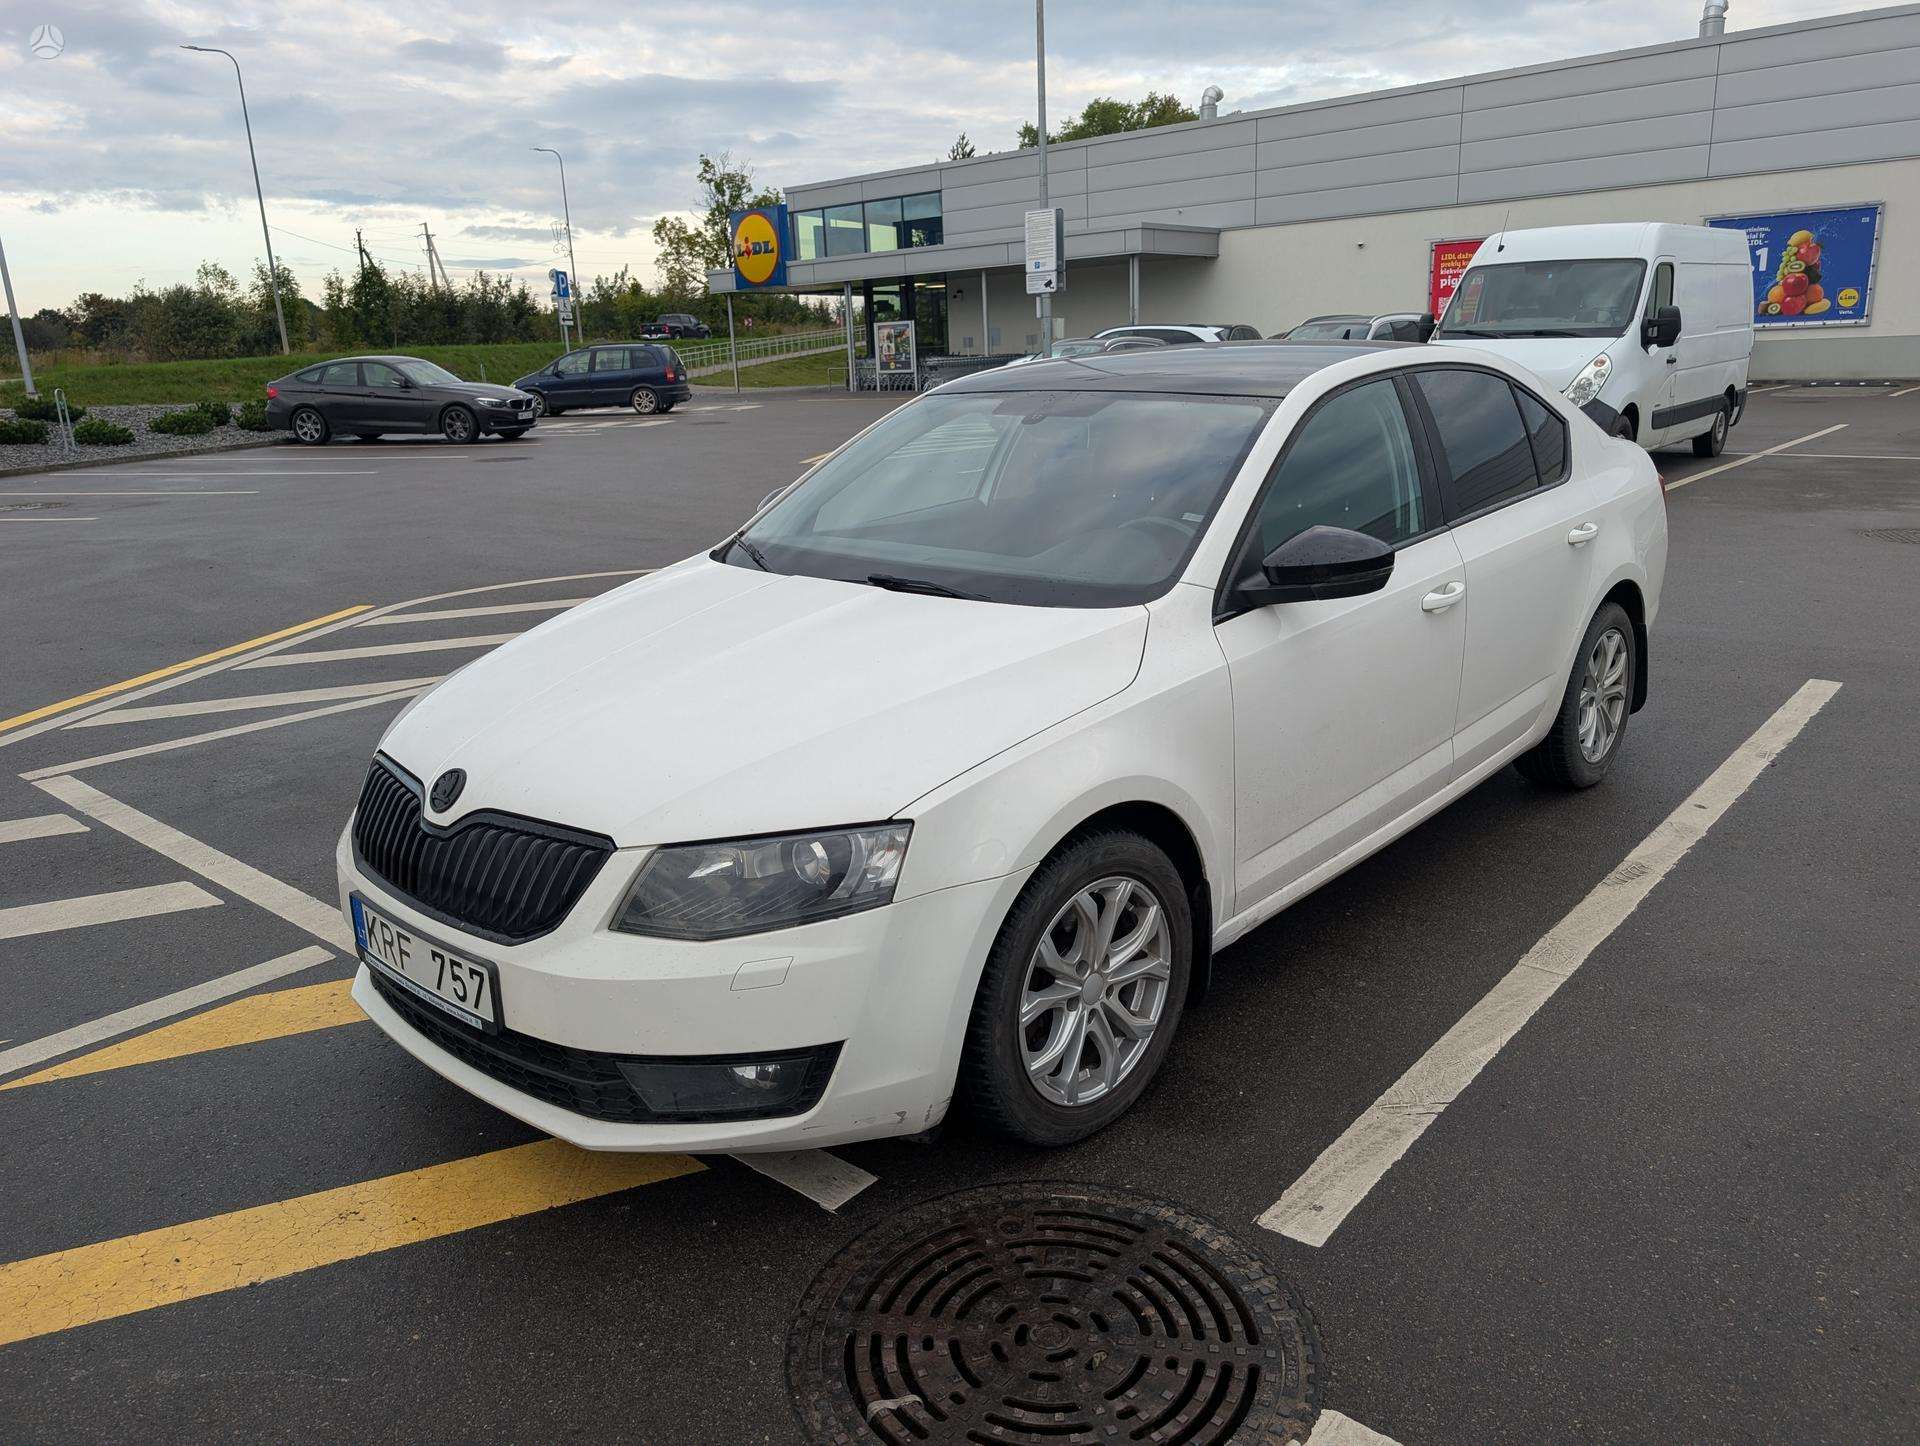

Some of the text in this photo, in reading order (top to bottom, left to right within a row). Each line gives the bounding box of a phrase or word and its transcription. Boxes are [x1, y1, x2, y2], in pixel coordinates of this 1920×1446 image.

[559, 274, 566, 296] P
[365, 911, 411, 970] KRF
[431, 949, 484, 1010] 757
